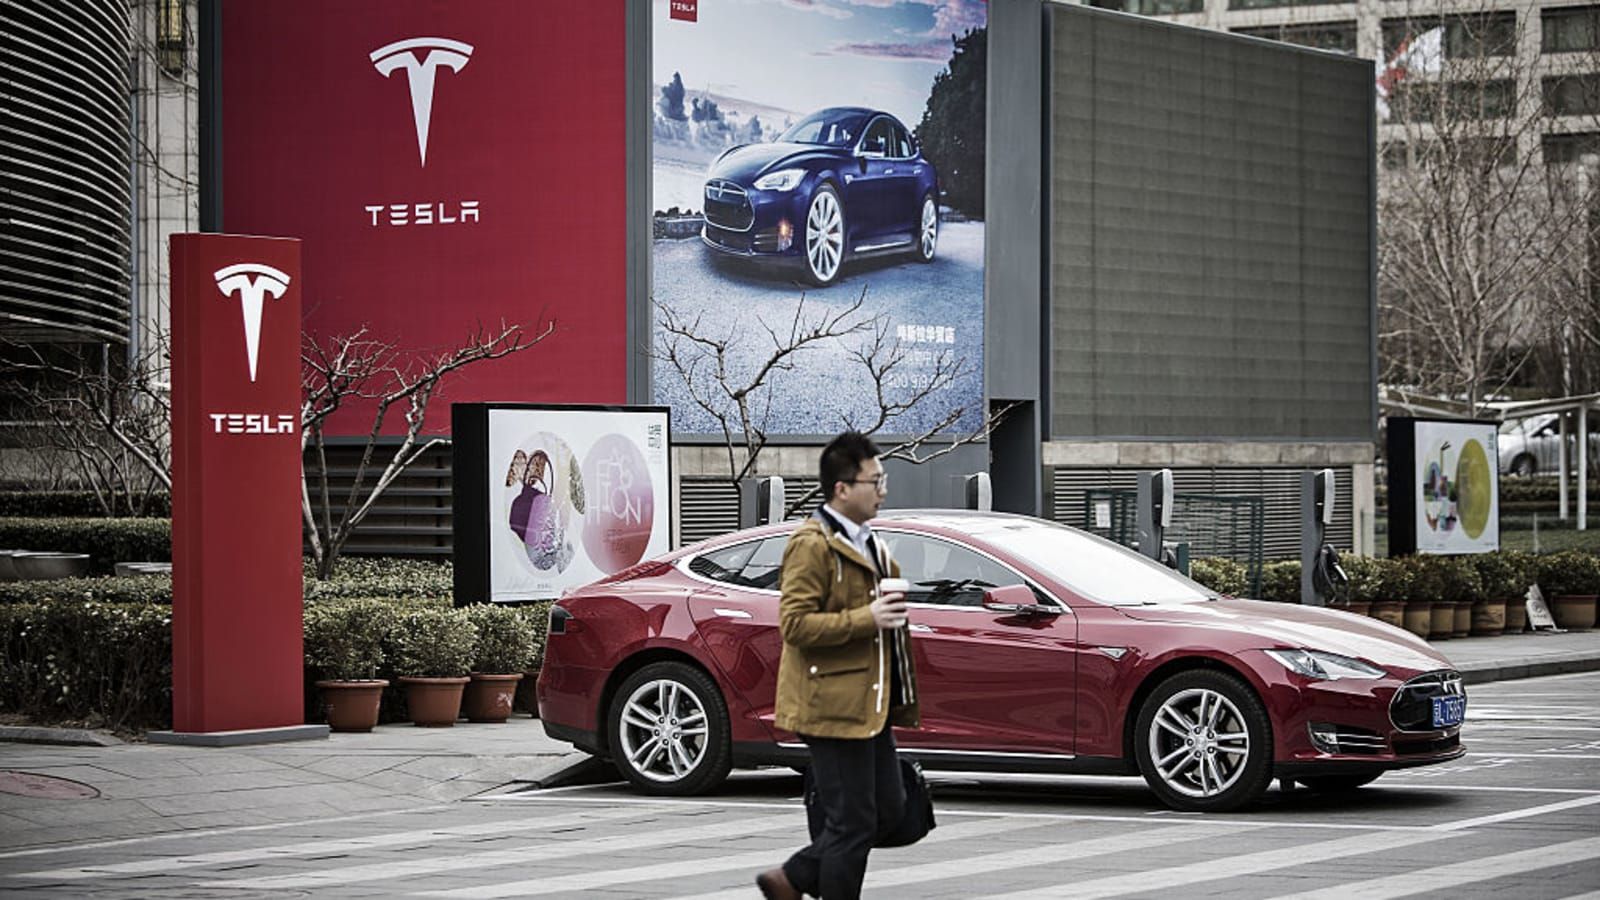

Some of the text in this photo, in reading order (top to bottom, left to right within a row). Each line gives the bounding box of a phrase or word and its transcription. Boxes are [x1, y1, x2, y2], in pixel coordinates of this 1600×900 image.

[672, 2, 695, 12] TESLA
[365, 201, 479, 226] TESLA
[209, 413, 294, 433] TESLA
